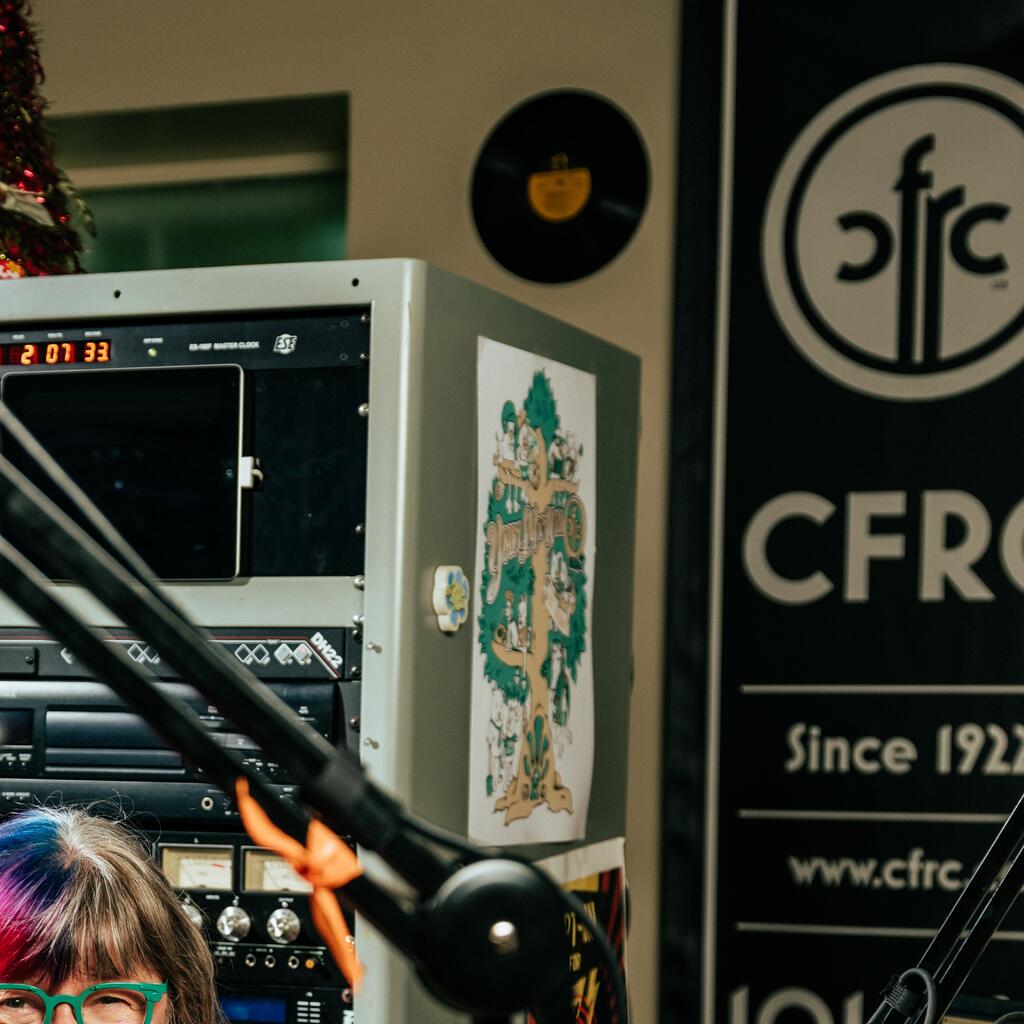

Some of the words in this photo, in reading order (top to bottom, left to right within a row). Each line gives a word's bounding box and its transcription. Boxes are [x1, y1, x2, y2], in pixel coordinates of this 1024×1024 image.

[21, 344, 35, 365] 2
[45, 343, 71, 364] 07
[274, 334, 298, 354] ESE
[741, 489, 1024, 606] CFR
[784, 721, 918, 775] Since
